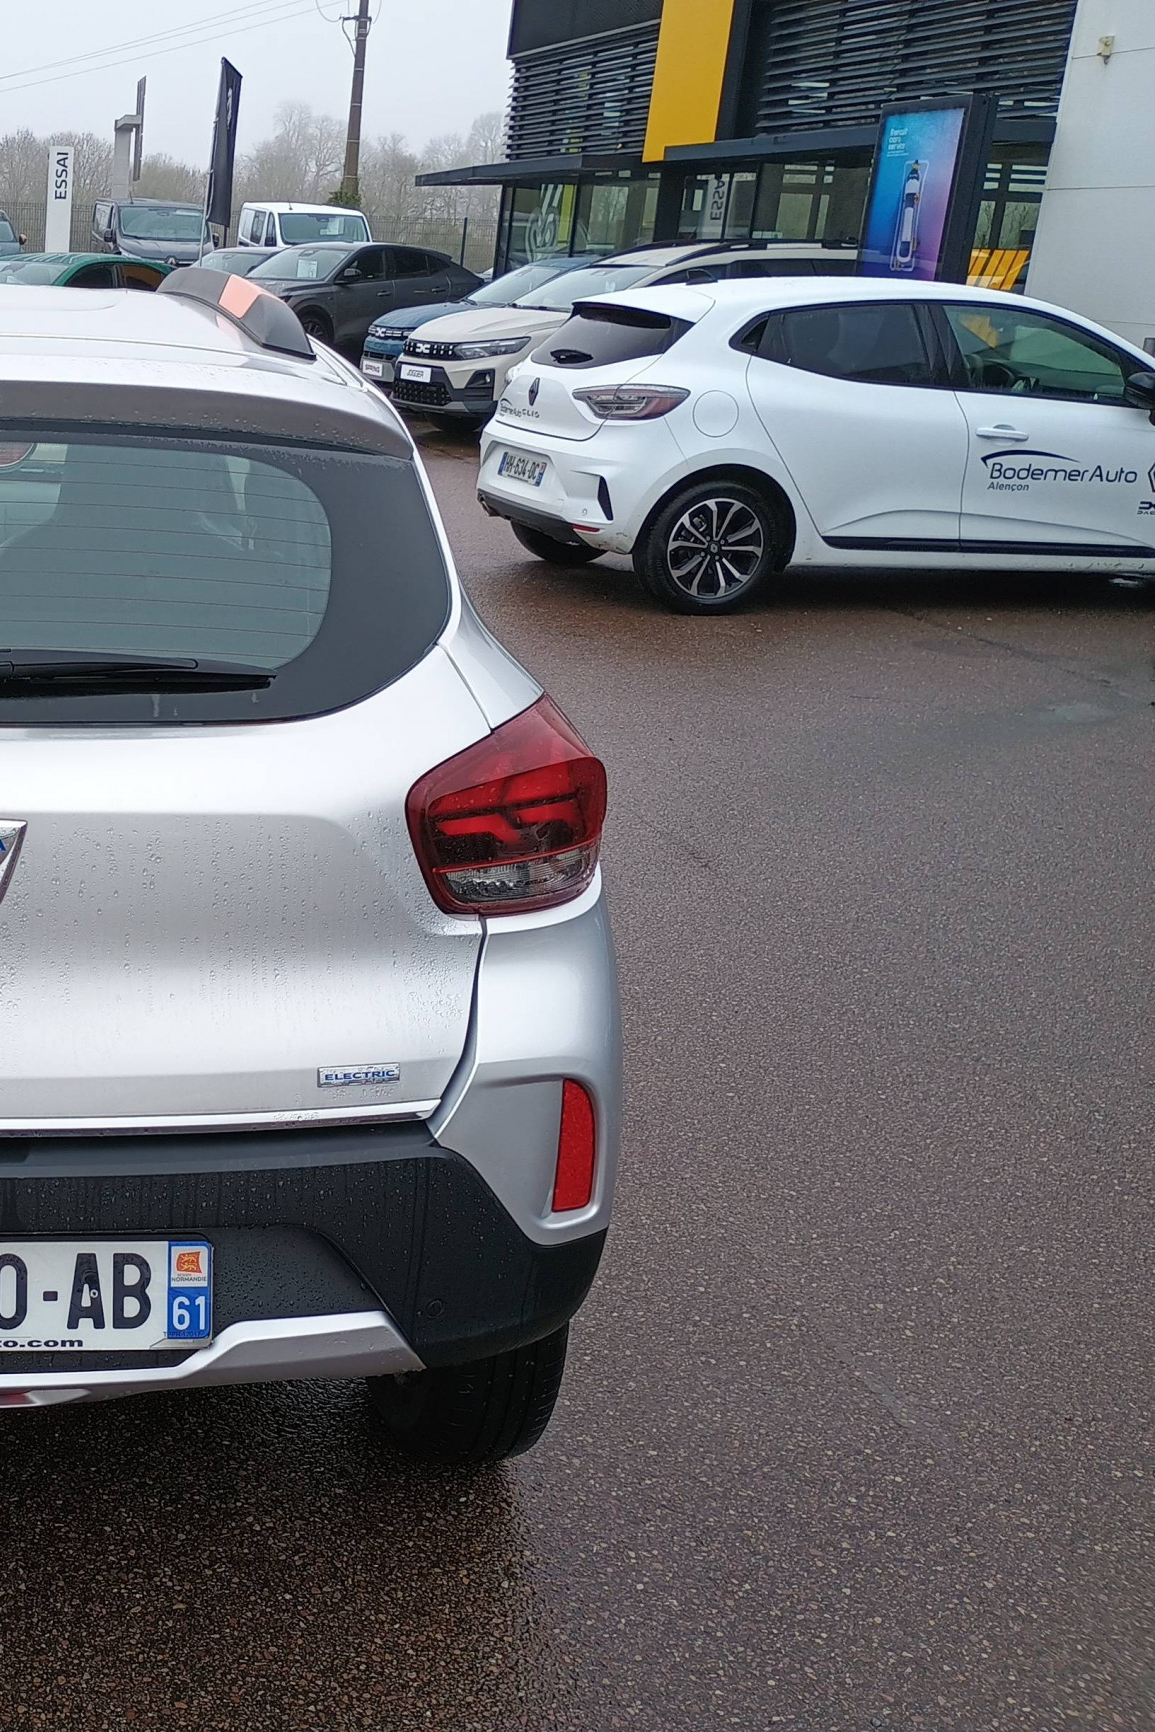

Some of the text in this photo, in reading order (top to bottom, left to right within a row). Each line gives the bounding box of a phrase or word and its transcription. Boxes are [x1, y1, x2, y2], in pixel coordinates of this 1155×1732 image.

[55, 152, 68, 200] ESSAI
[407, 369, 425, 378] JOGGER
[989, 462, 1138, 484] BodemerAuto
[987, 481, 1030, 492] Alençon
[324, 1069, 396, 1081] ELECTRIC
[172, 1295, 206, 1331] 61
